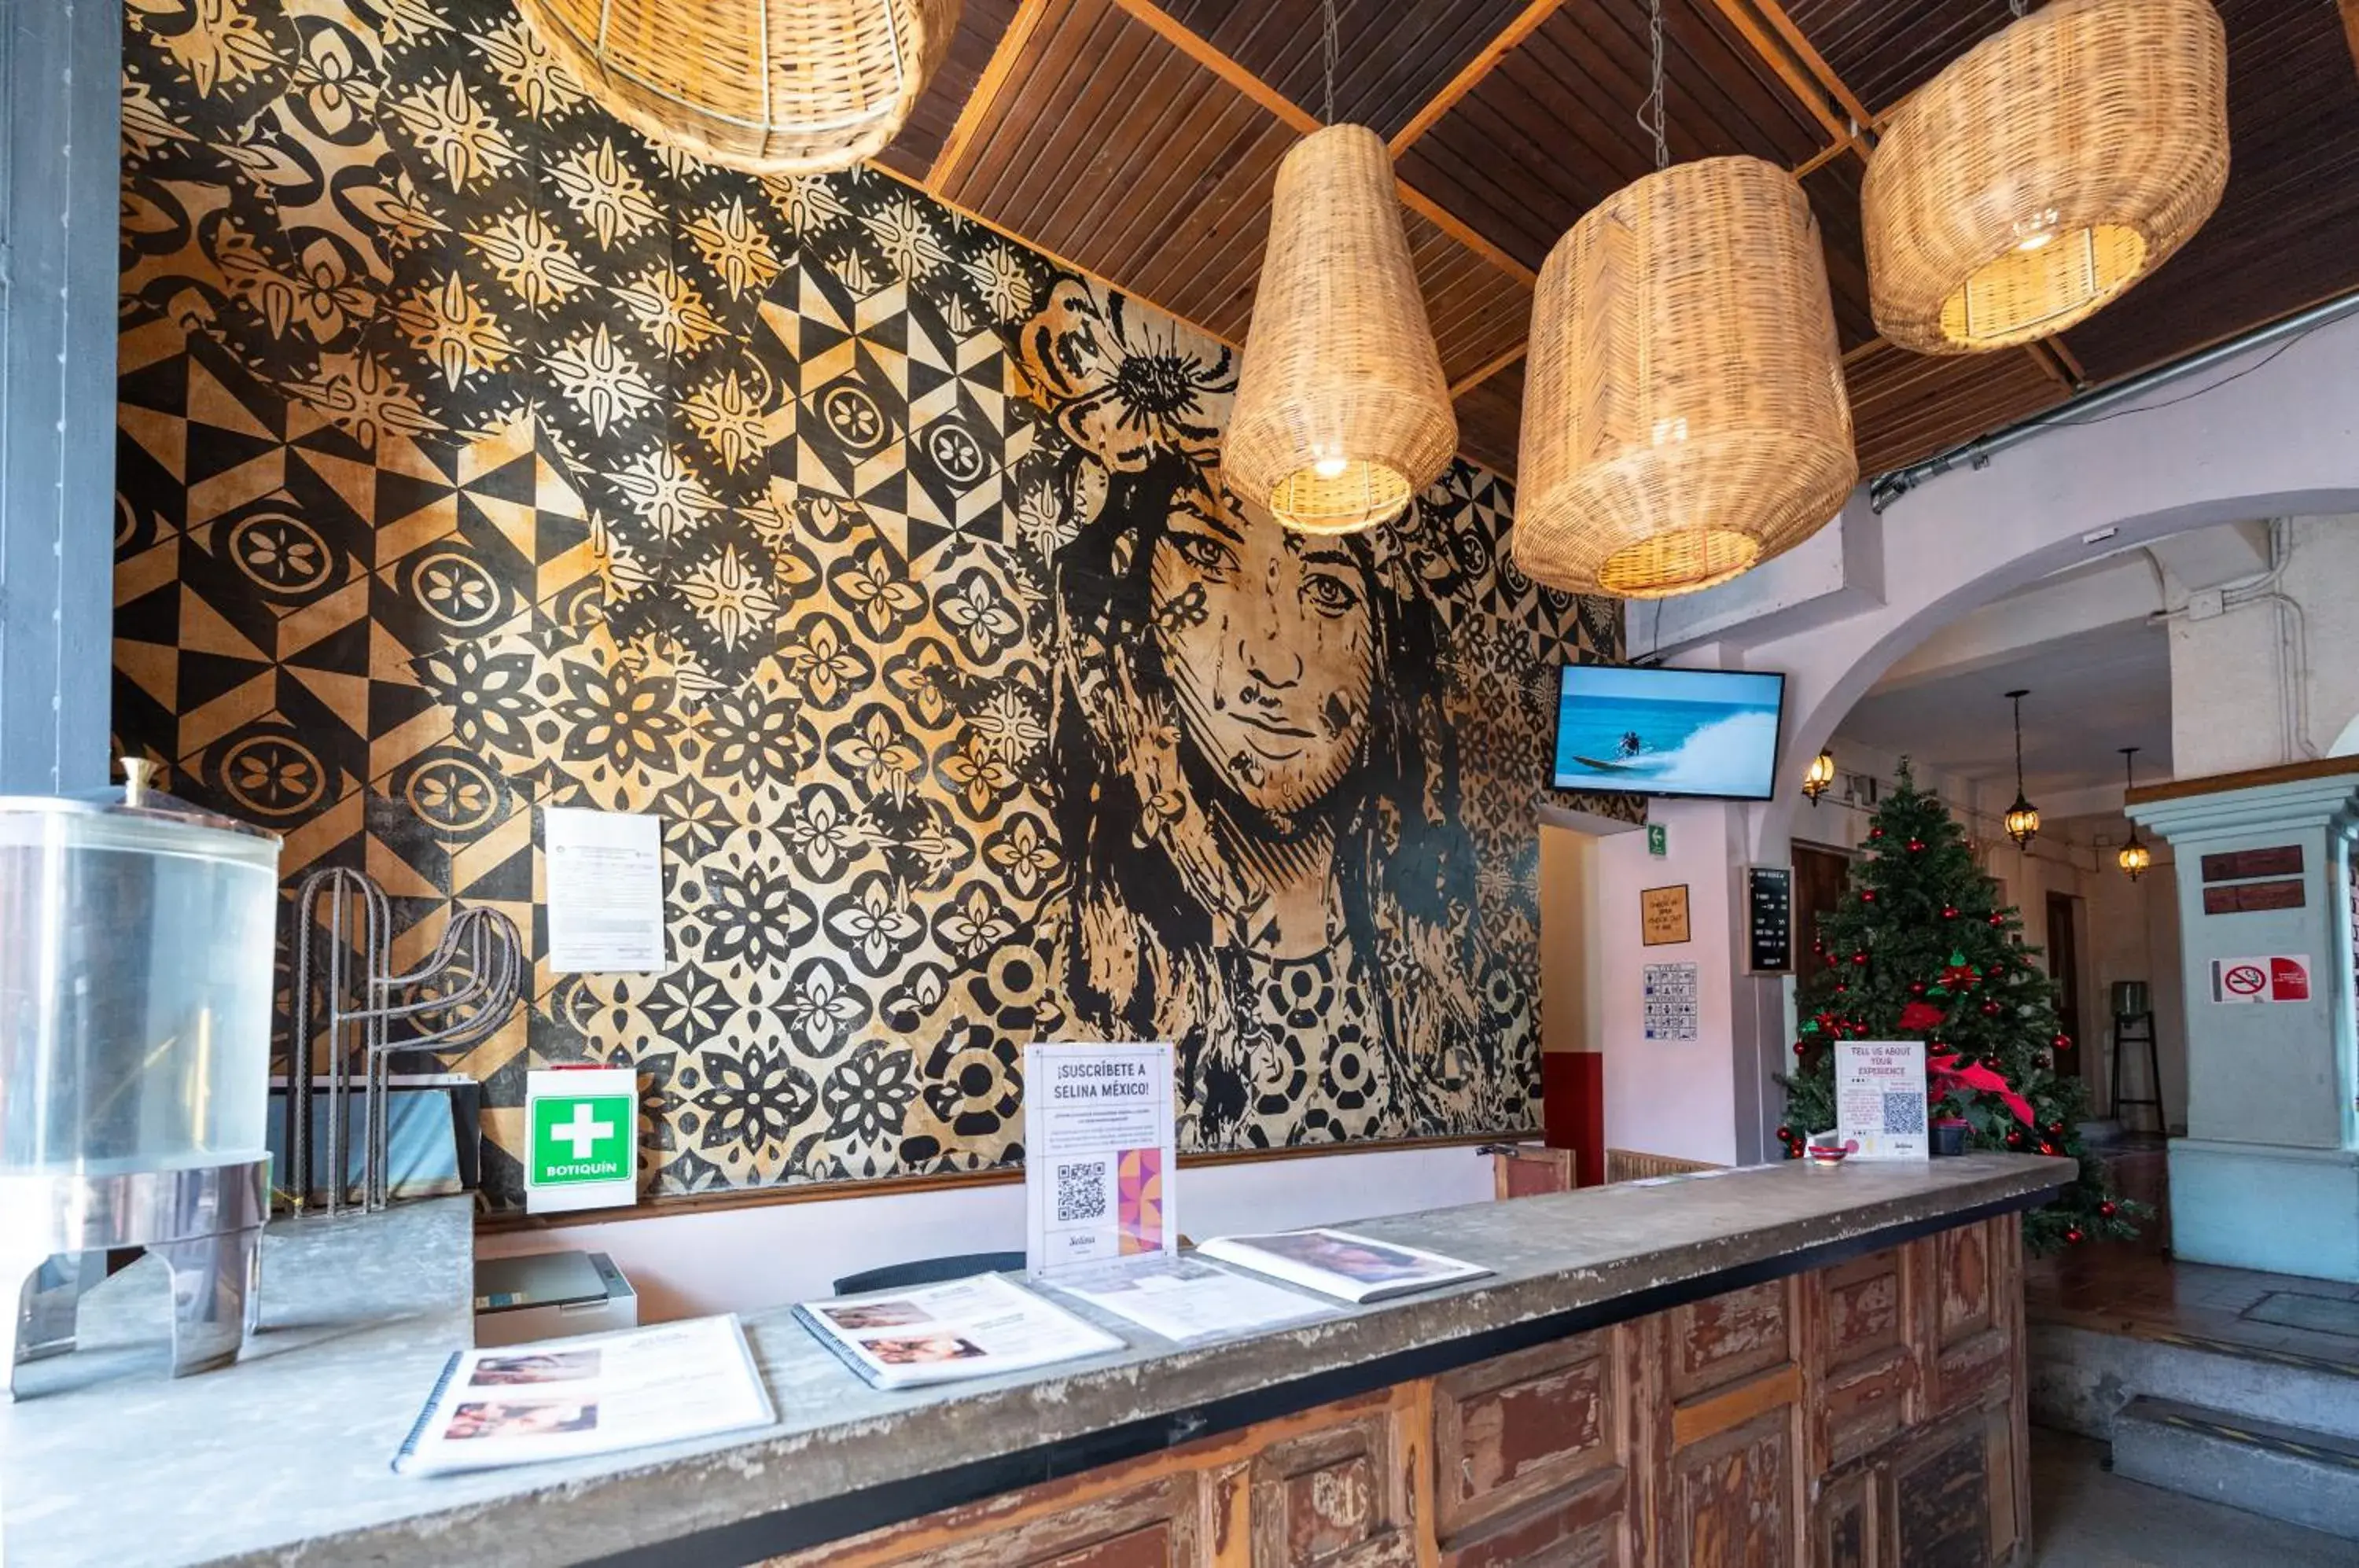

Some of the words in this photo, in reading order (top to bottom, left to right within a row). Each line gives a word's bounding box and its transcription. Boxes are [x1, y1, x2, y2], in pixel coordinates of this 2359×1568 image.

[1850, 1047, 1870, 1056] TELL
[1872, 1047, 1883, 1056] US
[1885, 1047, 1912, 1056] ABOUT
[1058, 1060, 1135, 1080] ¡SUSCRÍBETE
[1138, 1063, 1146, 1076] A
[1858, 1066, 1906, 1075] EXPERIENCE
[1054, 1084, 1098, 1099] SELINA
[1102, 1080, 1149, 1096] MÉXICO!
[547, 1161, 617, 1177] BOTIQUÍN
